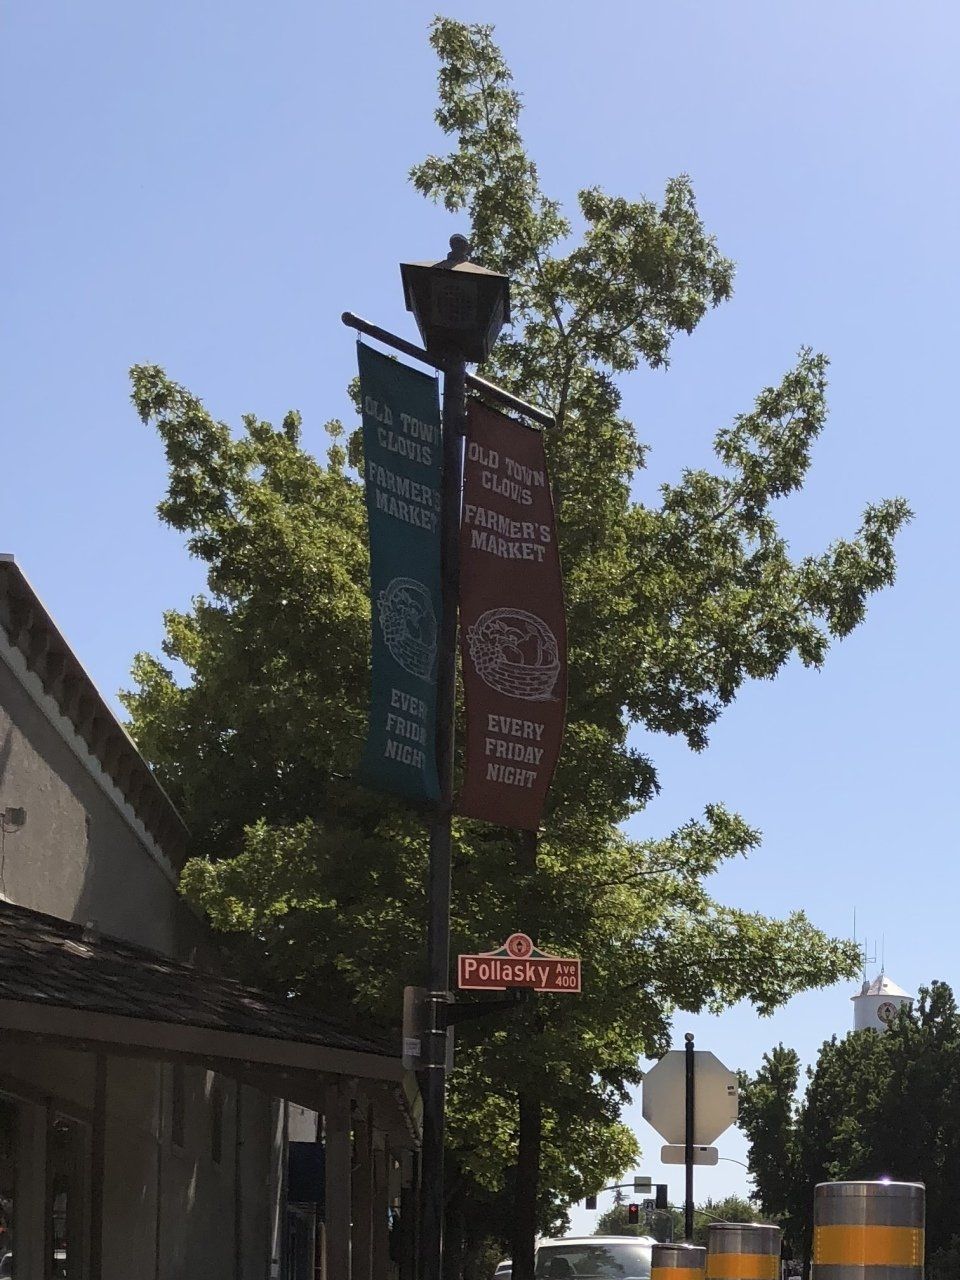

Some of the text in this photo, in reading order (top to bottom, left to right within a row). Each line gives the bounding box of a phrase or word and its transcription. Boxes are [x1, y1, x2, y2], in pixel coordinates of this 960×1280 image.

[364, 396, 393, 426] OLD
[377, 430, 433, 466] CLOVIS
[468, 442, 545, 487] OLD TOWN
[481, 470, 533, 506] CLOVIS
[463, 504, 551, 543] FARMER'S
[471, 530, 546, 563] MARKET
[487, 713, 545, 741] EVERY
[485, 737, 545, 765] FRIDAY
[486, 763, 538, 789] NIGHT
[465, 959, 576, 988] Pollasky Ave
[555, 976, 577, 987] 400
